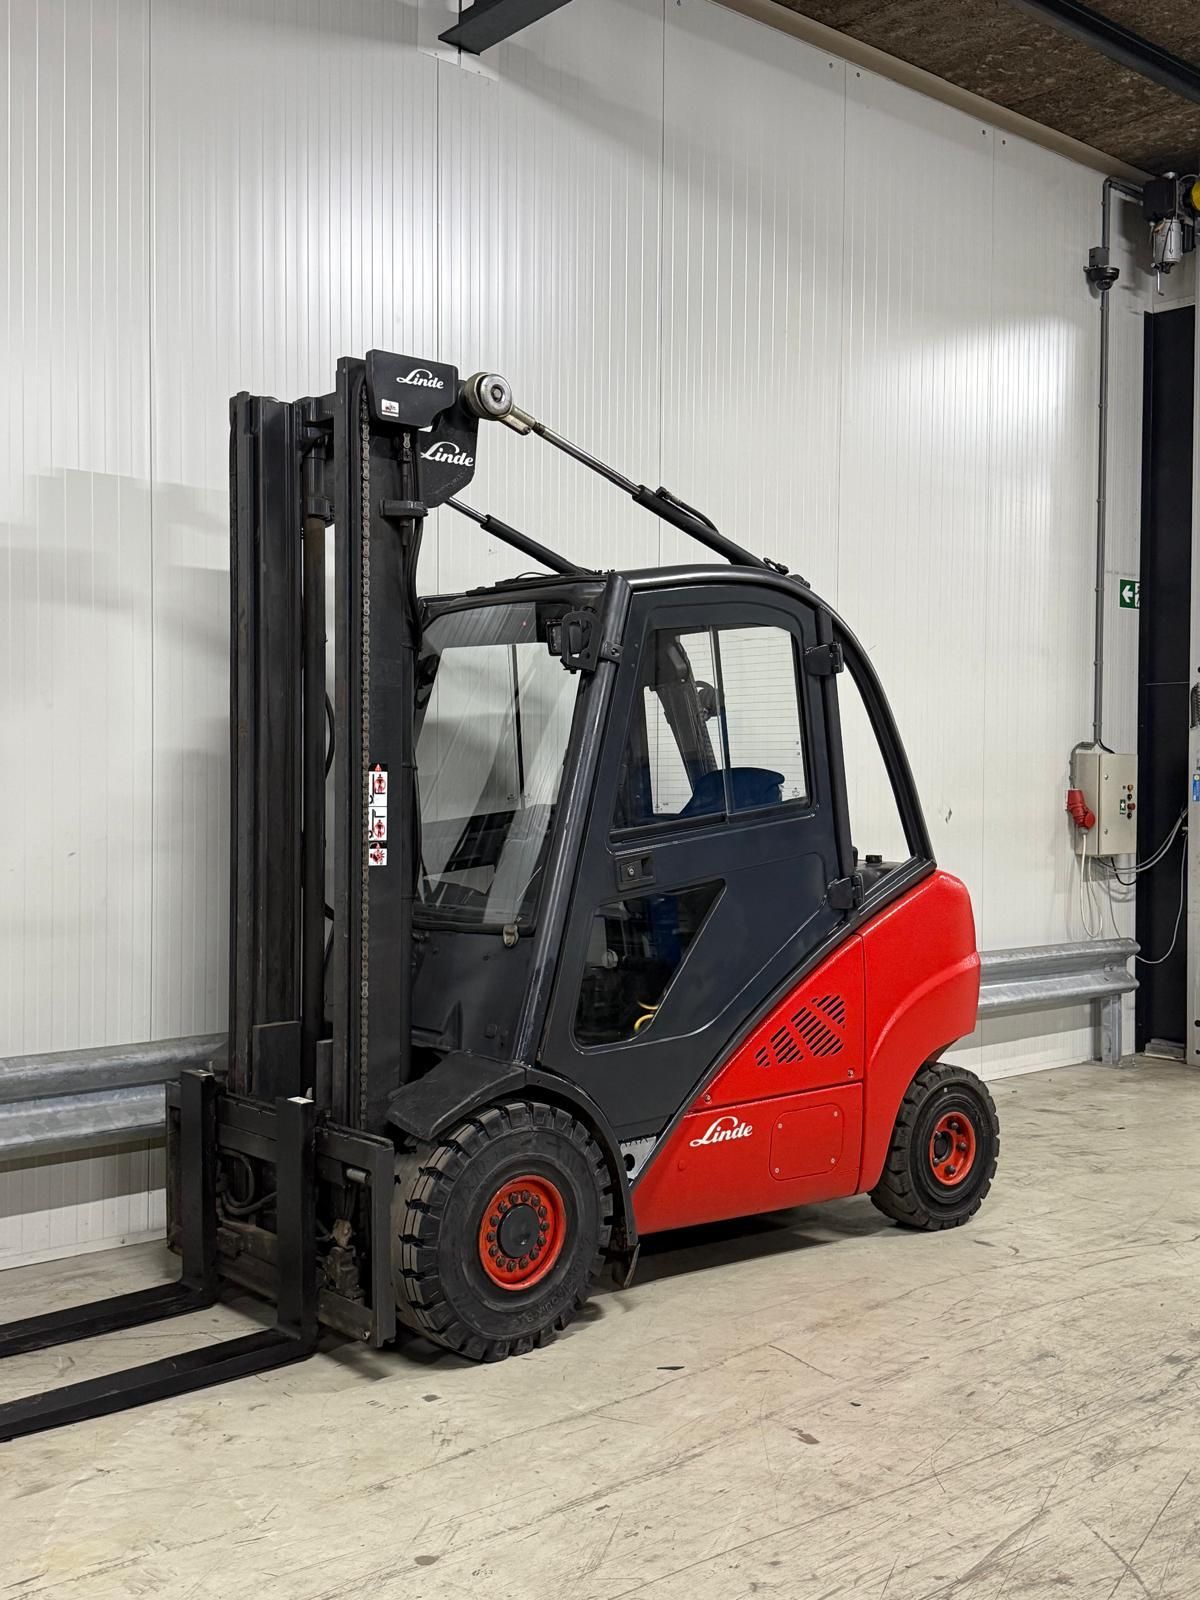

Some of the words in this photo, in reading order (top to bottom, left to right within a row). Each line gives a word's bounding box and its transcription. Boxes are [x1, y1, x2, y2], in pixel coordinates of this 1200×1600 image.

[396, 368, 444, 389] Linde
[420, 441, 473, 466] Linde
[689, 1116, 753, 1147] Linde
